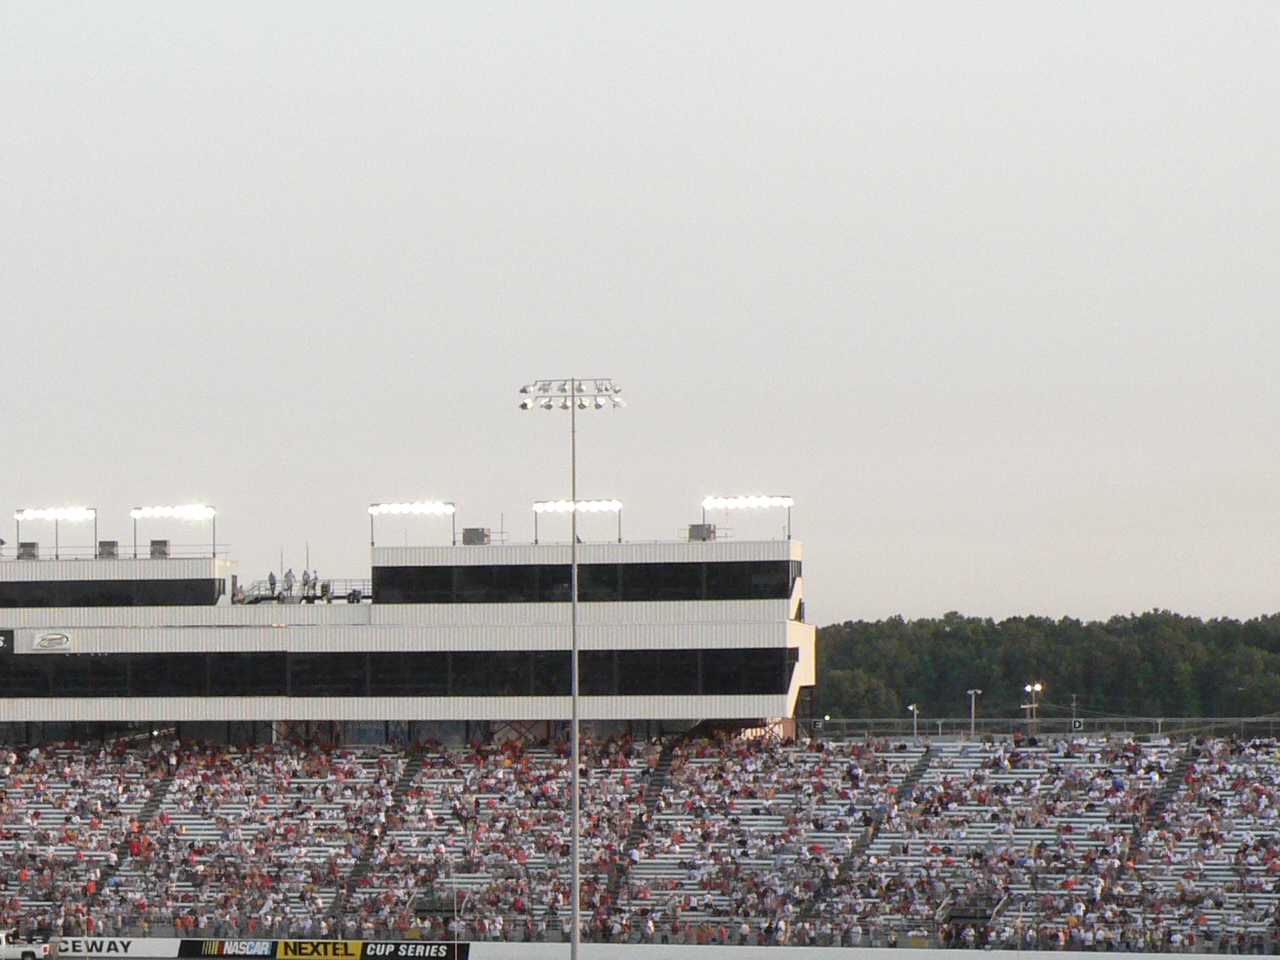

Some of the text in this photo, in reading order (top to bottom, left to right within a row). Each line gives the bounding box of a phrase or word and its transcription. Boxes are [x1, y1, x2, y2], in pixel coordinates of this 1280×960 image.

[59, 939, 132, 954] CEWAY
[222, 941, 448, 957] NASCAR NEXTEL CUP SERIES
